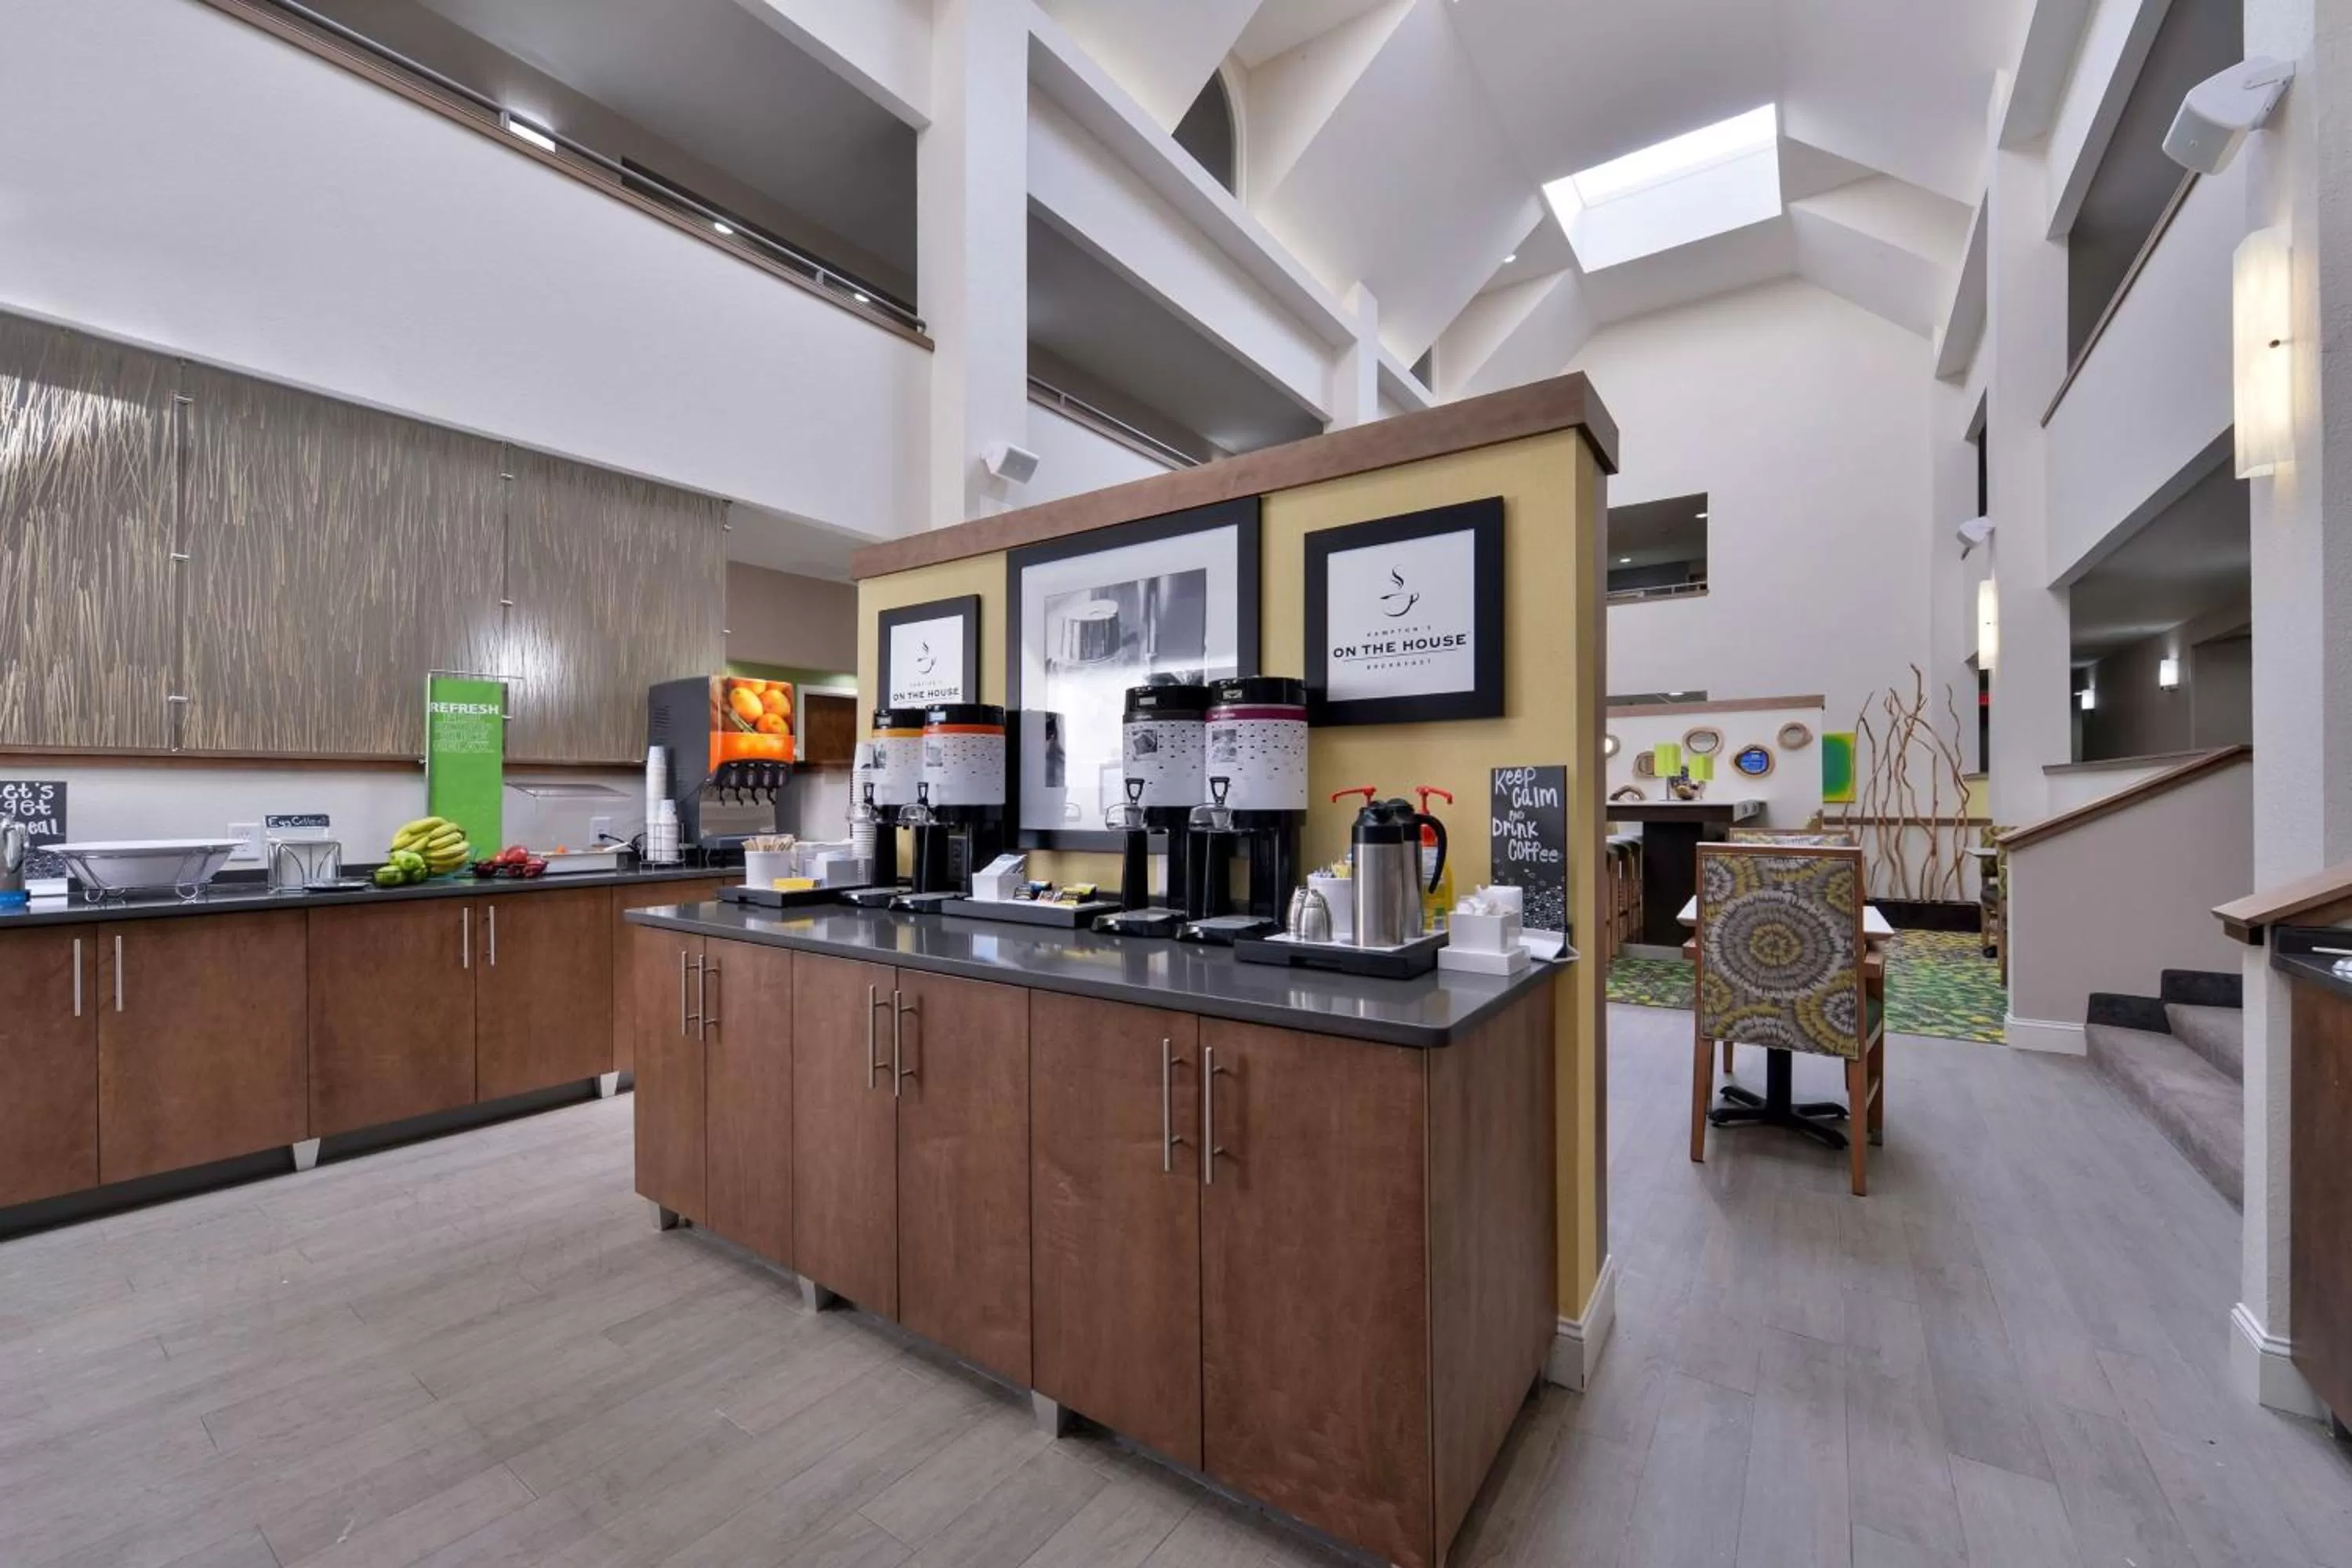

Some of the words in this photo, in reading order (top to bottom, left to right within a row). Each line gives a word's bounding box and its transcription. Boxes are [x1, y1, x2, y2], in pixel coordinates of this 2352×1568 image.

[1333, 646, 1356, 658] ON
[1362, 641, 1396, 655] THE
[1403, 633, 1467, 652] HOUSE
[892, 691, 906, 702] ON
[907, 691, 925, 699] THE
[927, 687, 960, 698] HOUSE
[430, 702, 499, 715] REFRESH
[0, 782, 54, 800] et's
[1495, 767, 1537, 796] Keep
[4, 798, 52, 818] get
[1492, 817, 1538, 839] Drink
